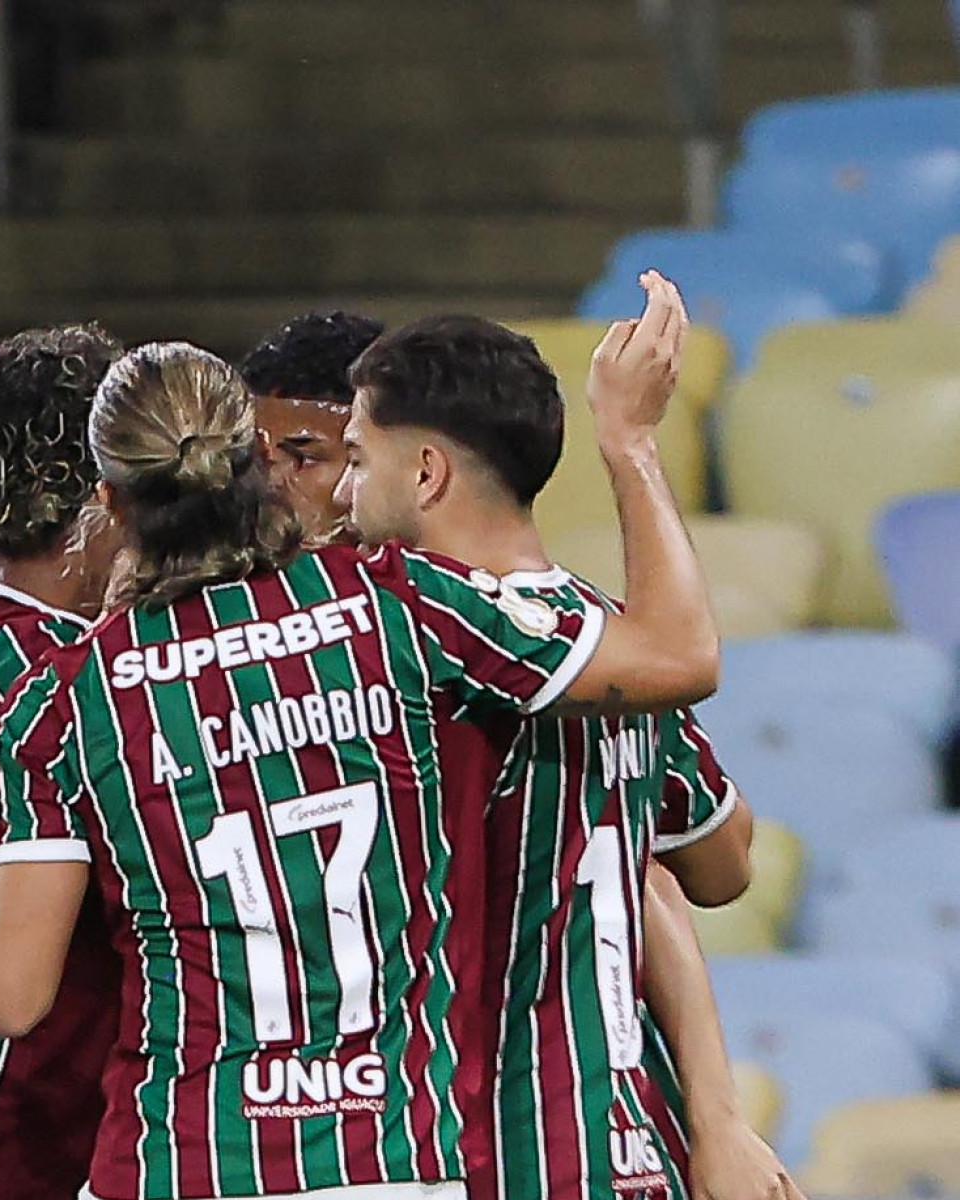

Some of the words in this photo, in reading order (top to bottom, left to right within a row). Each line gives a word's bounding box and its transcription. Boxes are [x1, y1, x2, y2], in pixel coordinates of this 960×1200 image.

[111, 594, 373, 689] SUPERBET
[200, 684, 393, 768] CANOBBIO
[195, 780, 378, 1042] 17
[244, 1053, 387, 1104] UNIG
